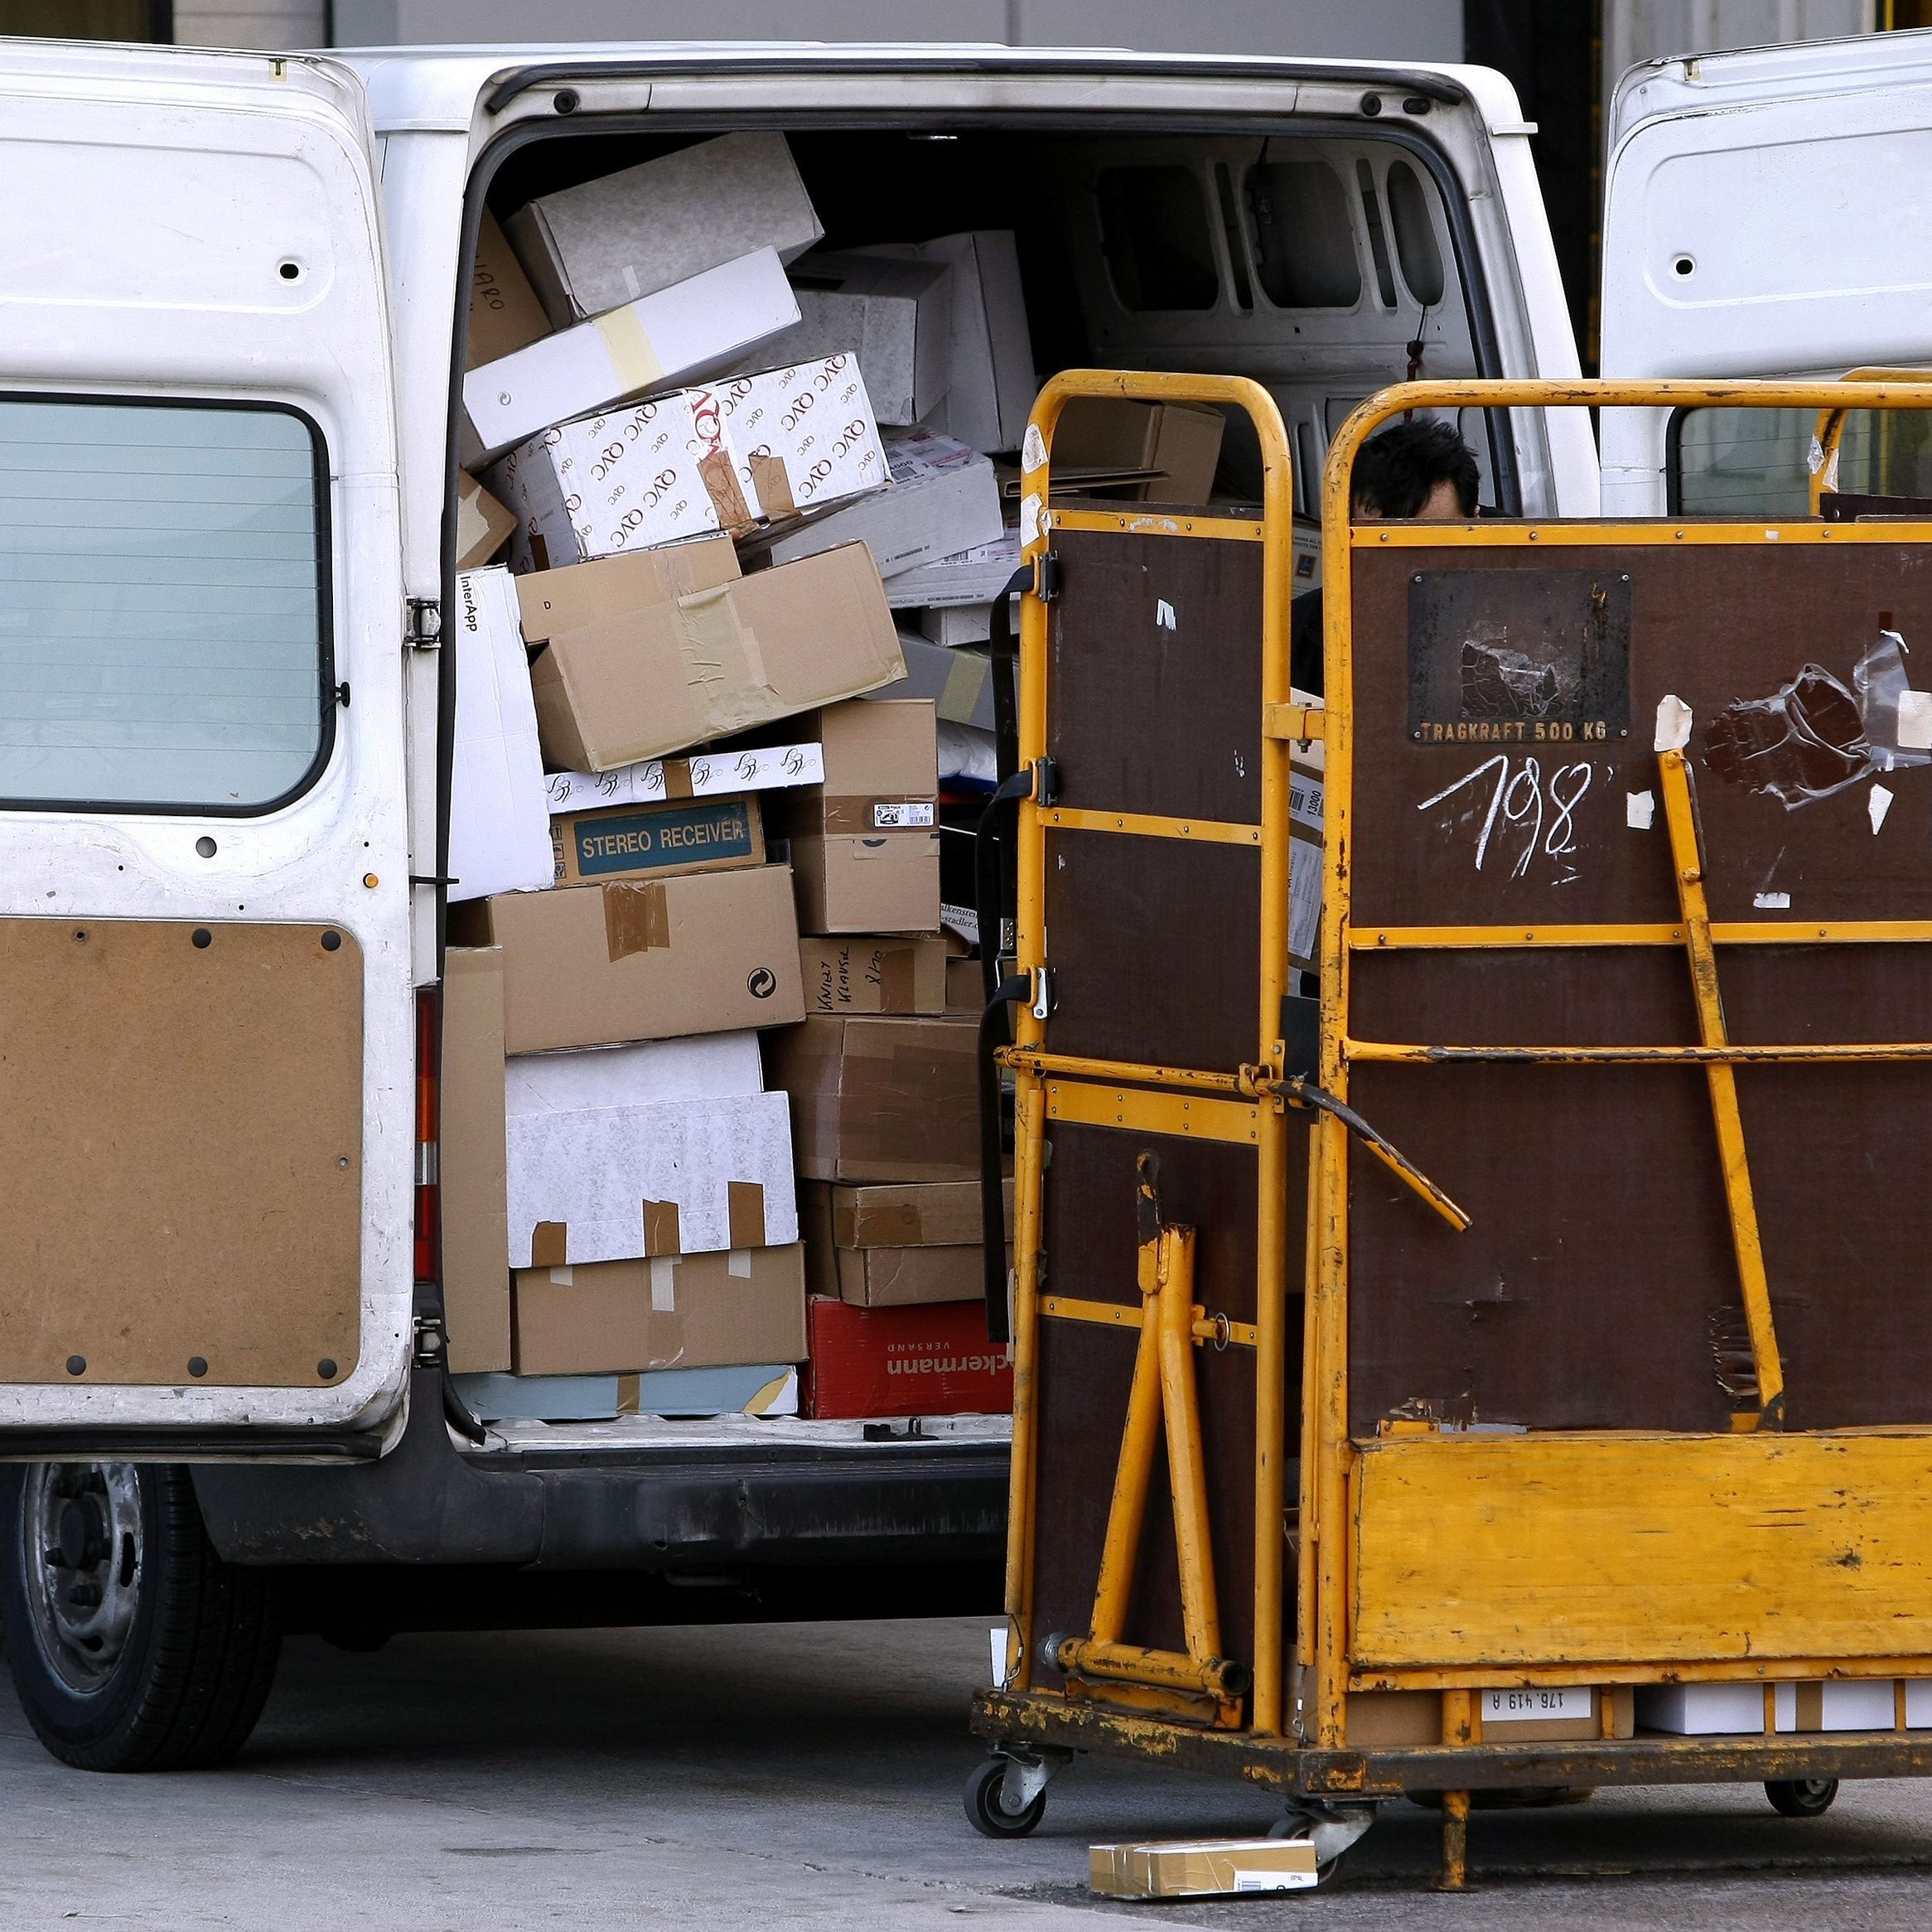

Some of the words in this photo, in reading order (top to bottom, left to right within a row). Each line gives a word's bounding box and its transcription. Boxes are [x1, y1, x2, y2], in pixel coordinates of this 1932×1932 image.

[779, 368, 796, 389] QVC
[814, 355, 847, 392] QVC
[721, 377, 752, 416] QVC
[840, 383, 857, 404] QVC
[624, 403, 658, 442] QVC
[746, 408, 764, 428] QVC
[780, 391, 814, 432] QVC
[587, 418, 606, 438] QVC
[832, 419, 866, 458] QVC
[651, 432, 669, 453] QVC
[796, 435, 814, 456] QVC
[591, 442, 625, 481] QVC
[857, 450, 876, 471] QVC
[643, 469, 677, 508] QVC
[799, 459, 833, 498] QVC
[607, 485, 625, 505] QVC
[669, 500, 688, 520] QVC
[610, 508, 644, 548] QVC
[460, 576, 477, 631] InterApp
[543, 601, 552, 610] D
[1420, 722, 1525, 741] TRAGKRAFT
[1535, 722, 1573, 741] 500
[1584, 720, 1606, 740] KG
[1307, 790, 1321, 816] 13000
[582, 830, 652, 859] STEREO
[660, 820, 744, 848] RECEIVER
[887, 1341, 951, 1352] VERSAND
[887, 1353, 1014, 1376] ckermann
[1493, 1693, 1500, 1710] A
